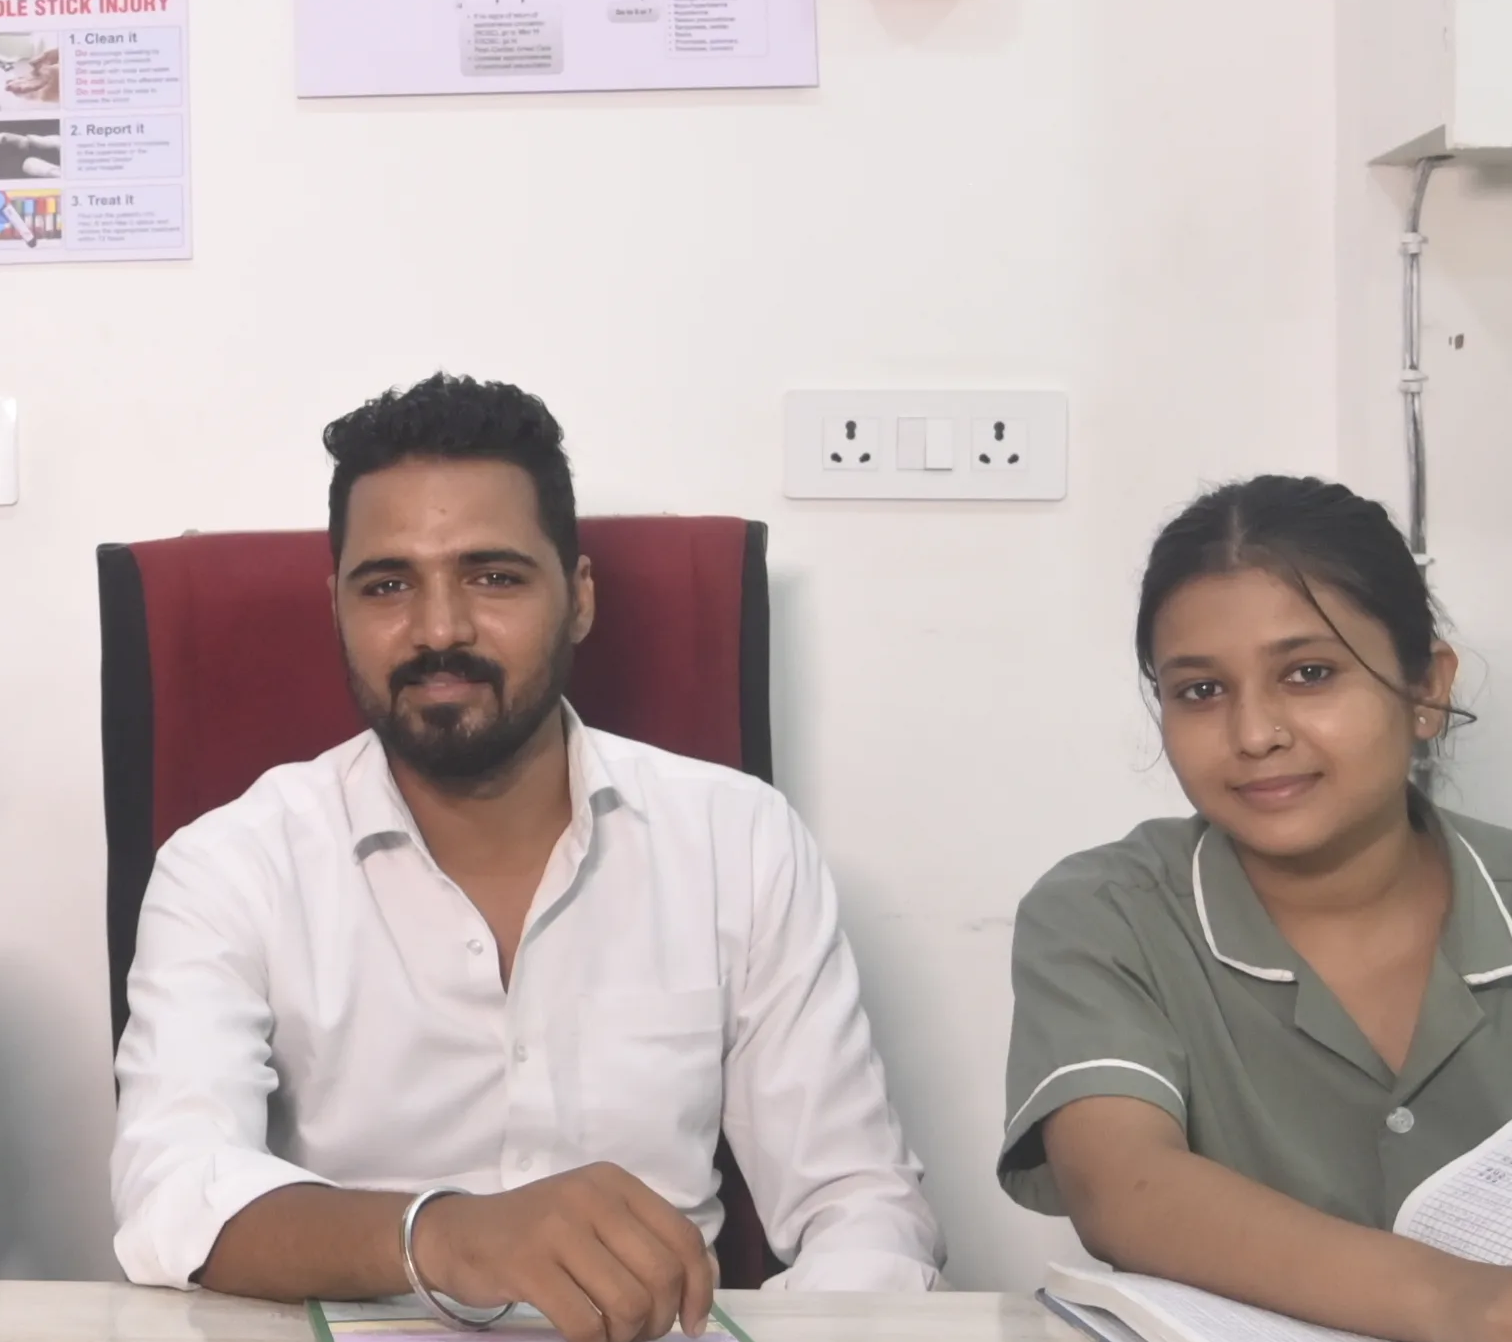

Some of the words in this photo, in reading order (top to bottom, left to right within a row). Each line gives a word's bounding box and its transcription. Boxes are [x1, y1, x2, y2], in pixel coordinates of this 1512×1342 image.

[70, 34, 80, 44] 1.
[85, 32, 125, 44] Clean
[128, 32, 137, 43] it
[71, 125, 81, 136] 2.
[86, 123, 132, 137] Report
[136, 123, 145, 134] it
[72, 196, 81, 207] 3.
[88, 195, 122, 206] Treat
[126, 195, 134, 205] it
